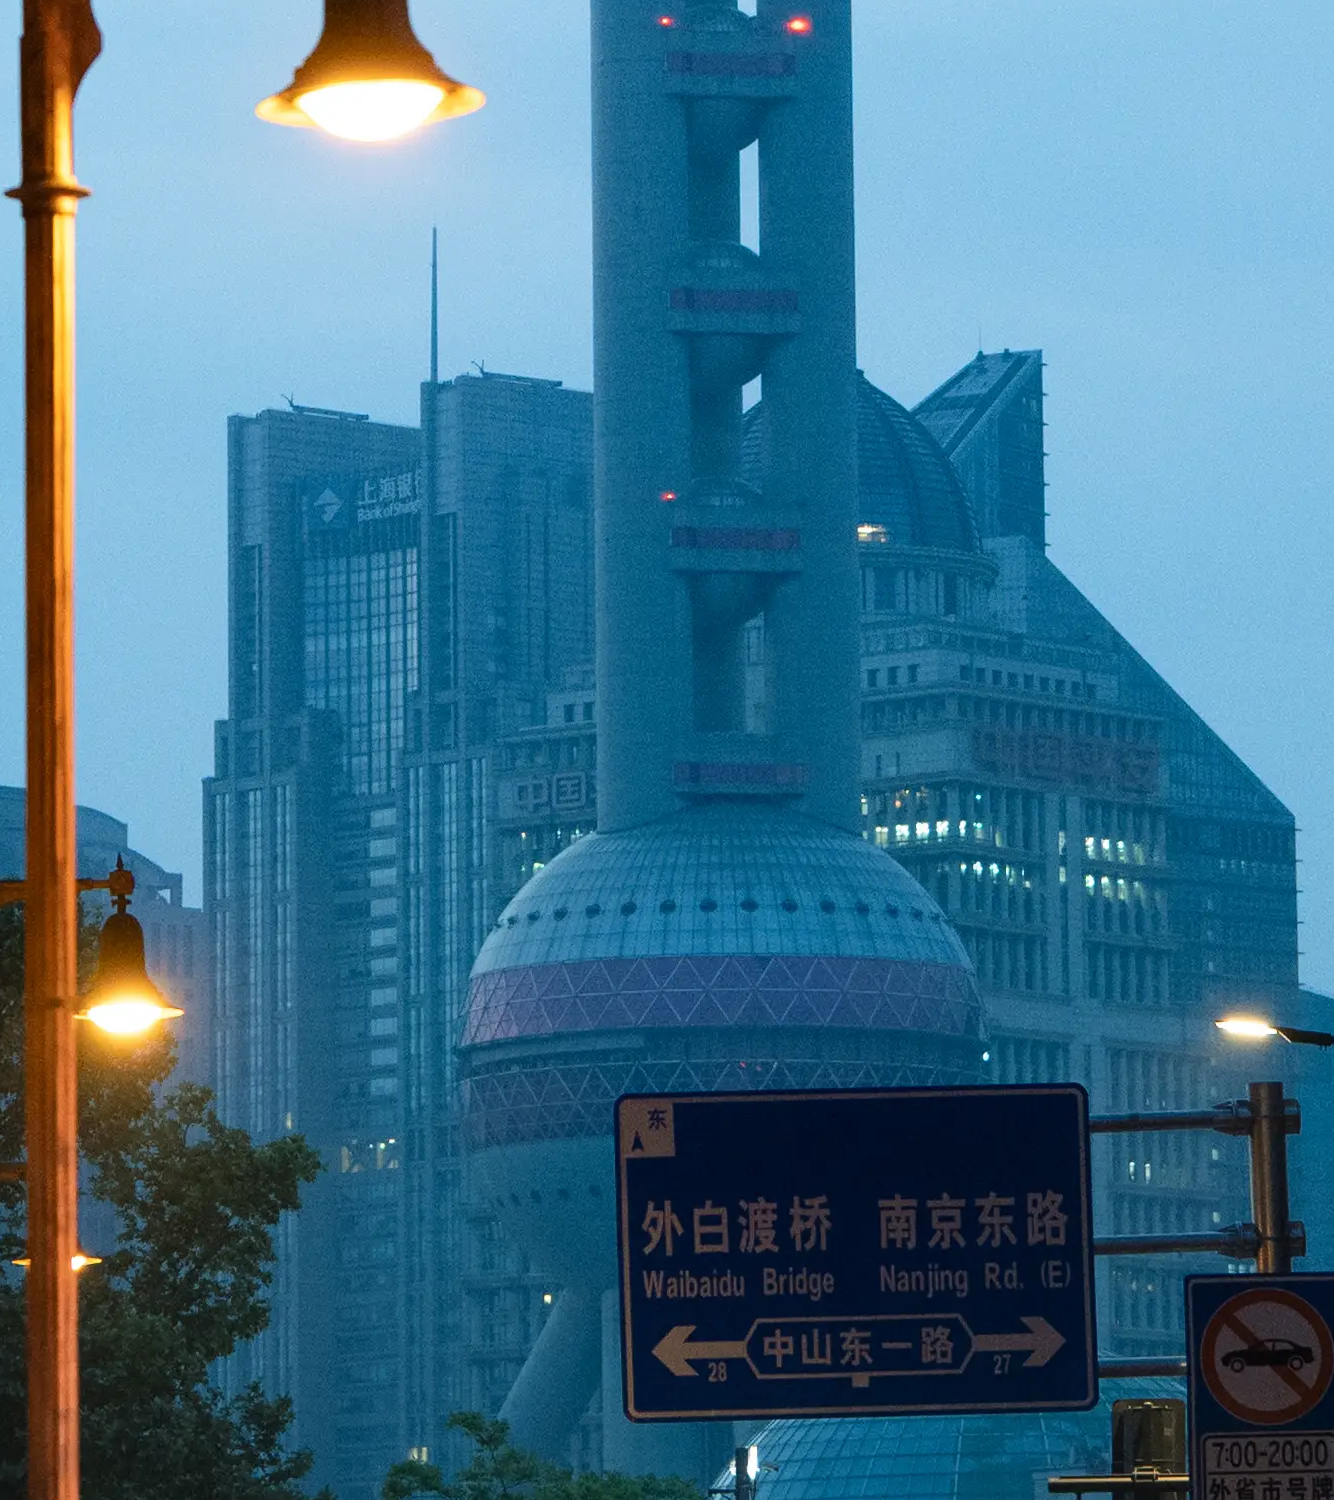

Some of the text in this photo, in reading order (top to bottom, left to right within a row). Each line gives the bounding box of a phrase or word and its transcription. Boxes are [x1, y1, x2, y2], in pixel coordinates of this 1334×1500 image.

[647, 1109, 667, 1131] 东
[642, 1195, 833, 1257] 外白渡桥
[878, 1189, 1068, 1250] 南京东路
[643, 1267, 835, 1301] Waibaidu Bridge
[880, 1260, 1071, 1298] Nanjing Rd. (E)
[763, 1325, 954, 1368] 中山东一路
[708, 1362, 727, 1382] 28
[993, 1354, 1011, 1375] 27
[1212, 1439, 1328, 1468] 7:00-20:00
